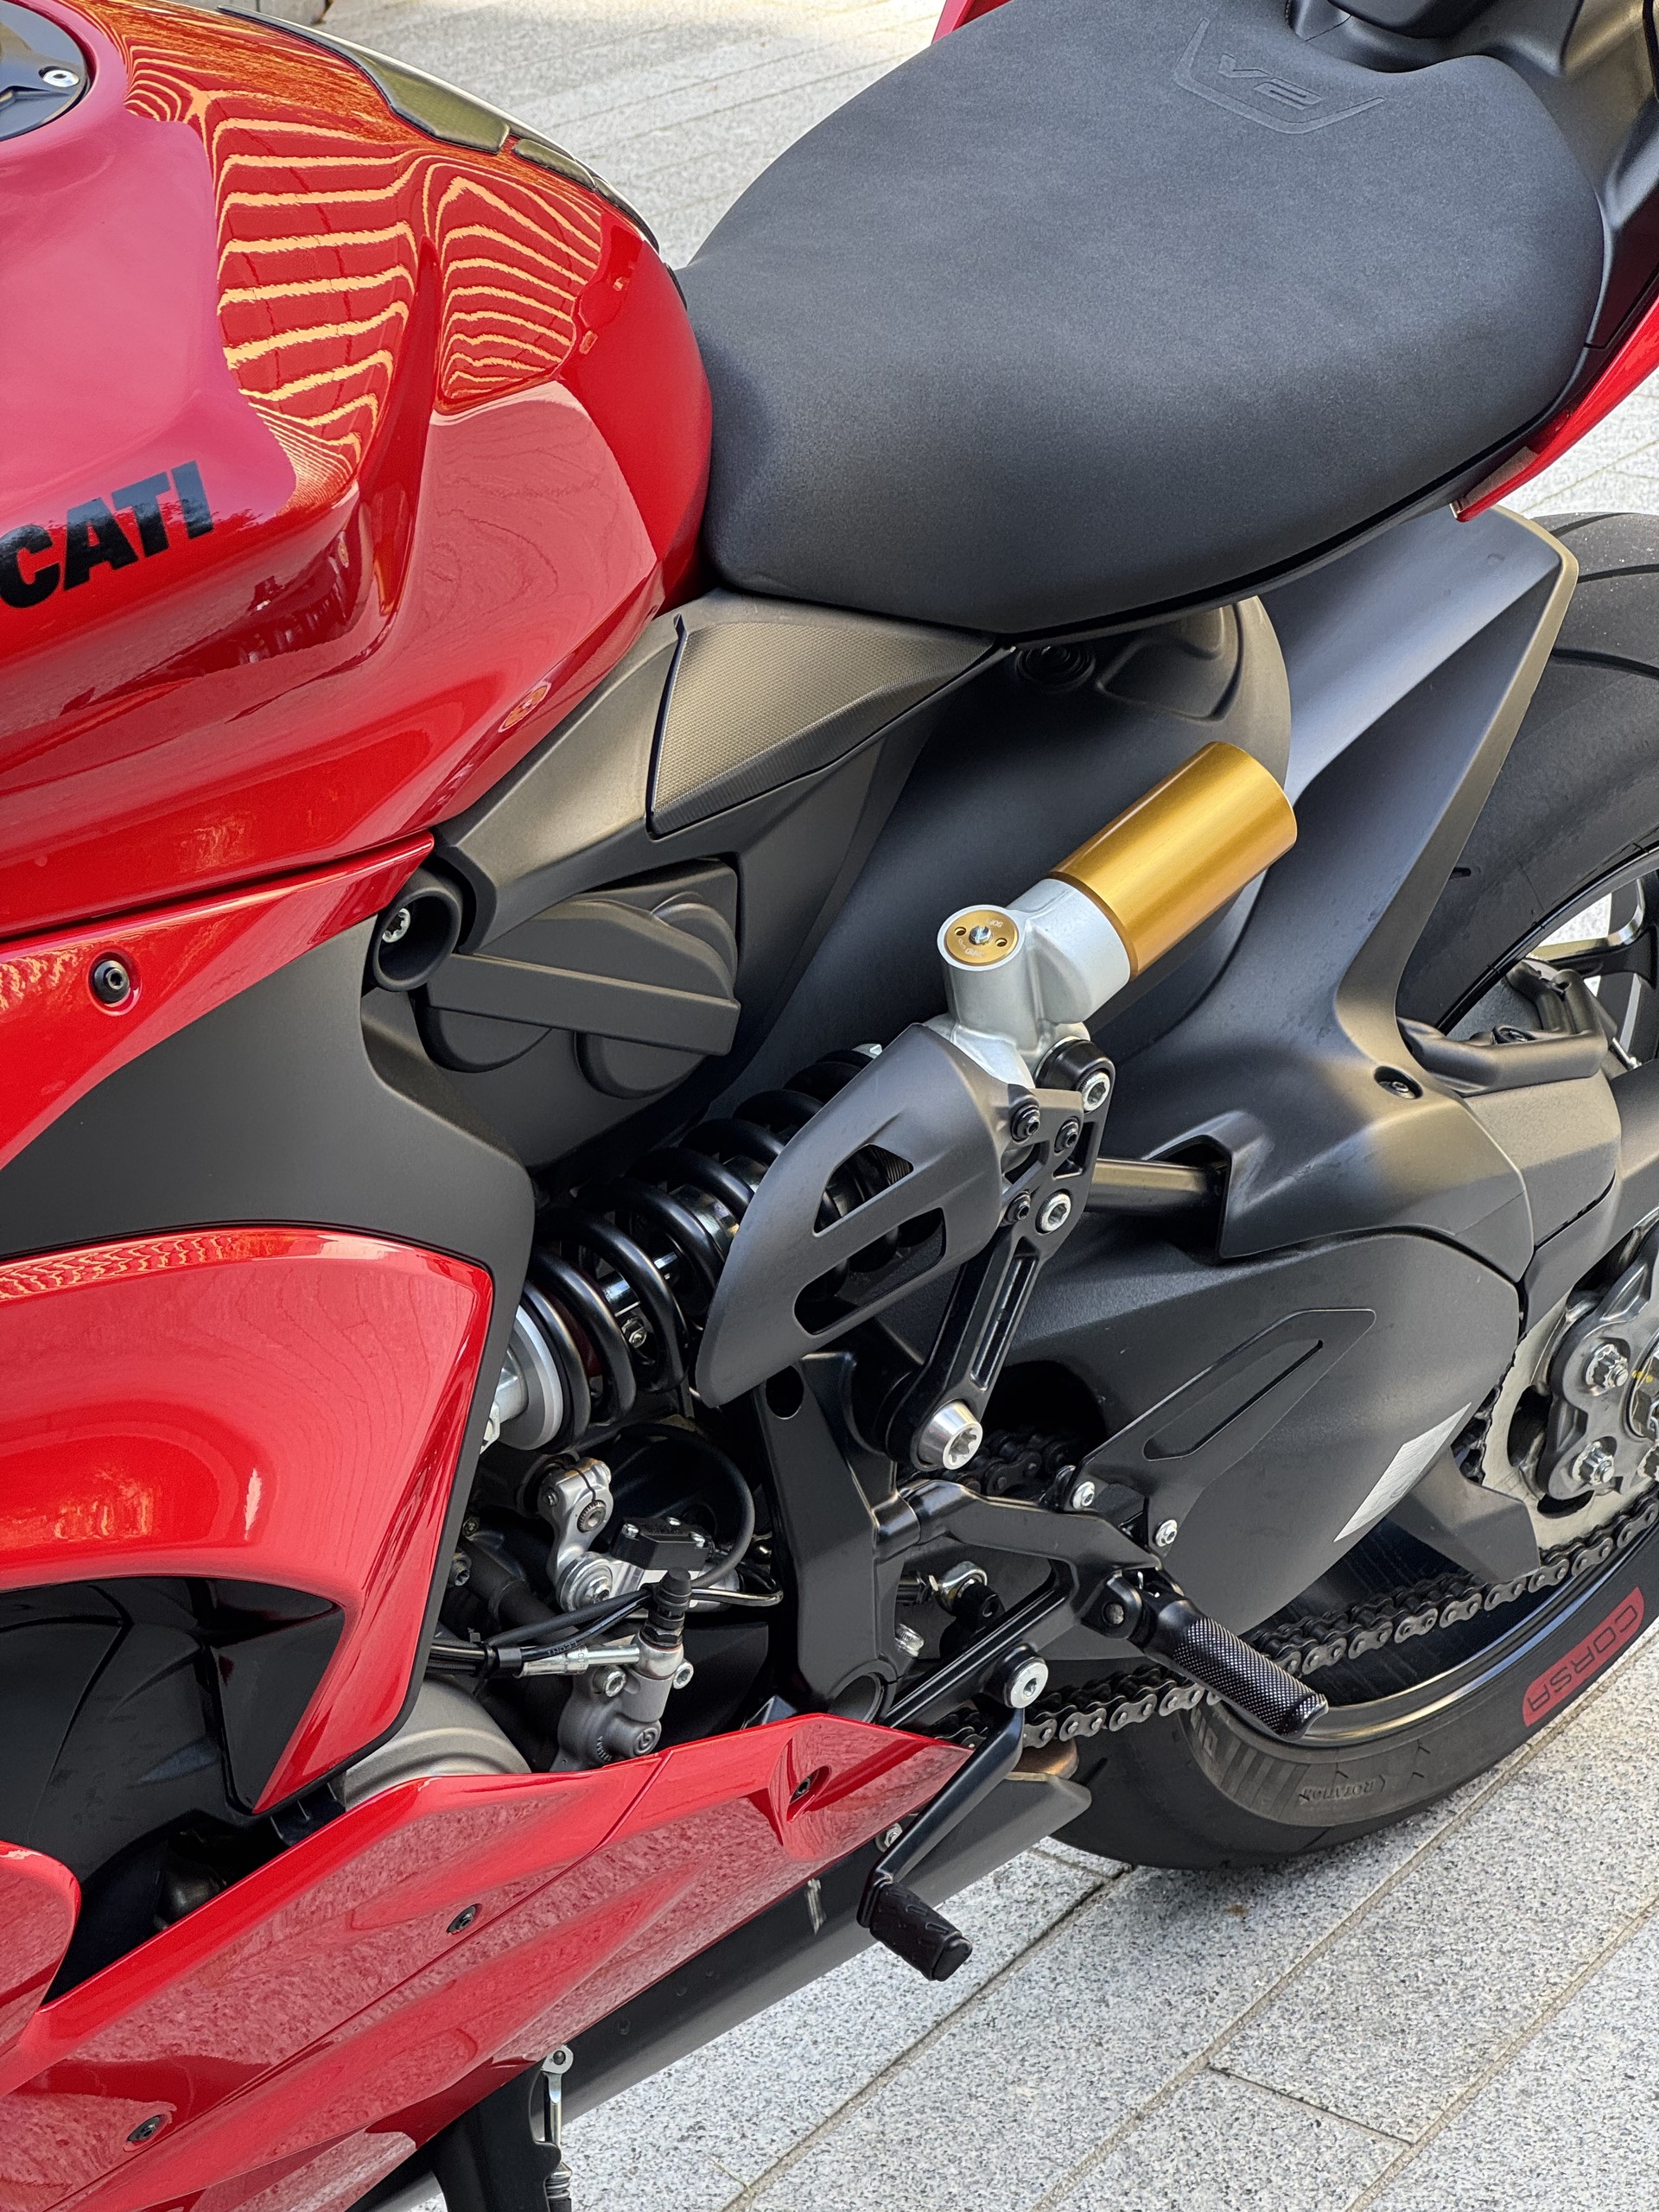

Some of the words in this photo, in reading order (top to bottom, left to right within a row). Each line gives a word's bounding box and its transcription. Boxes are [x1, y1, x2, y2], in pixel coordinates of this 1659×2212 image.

[1218, 53, 1325, 110] V2
[0, 460, 214, 609] CATI
[1527, 1605, 1638, 1712] CORSA
